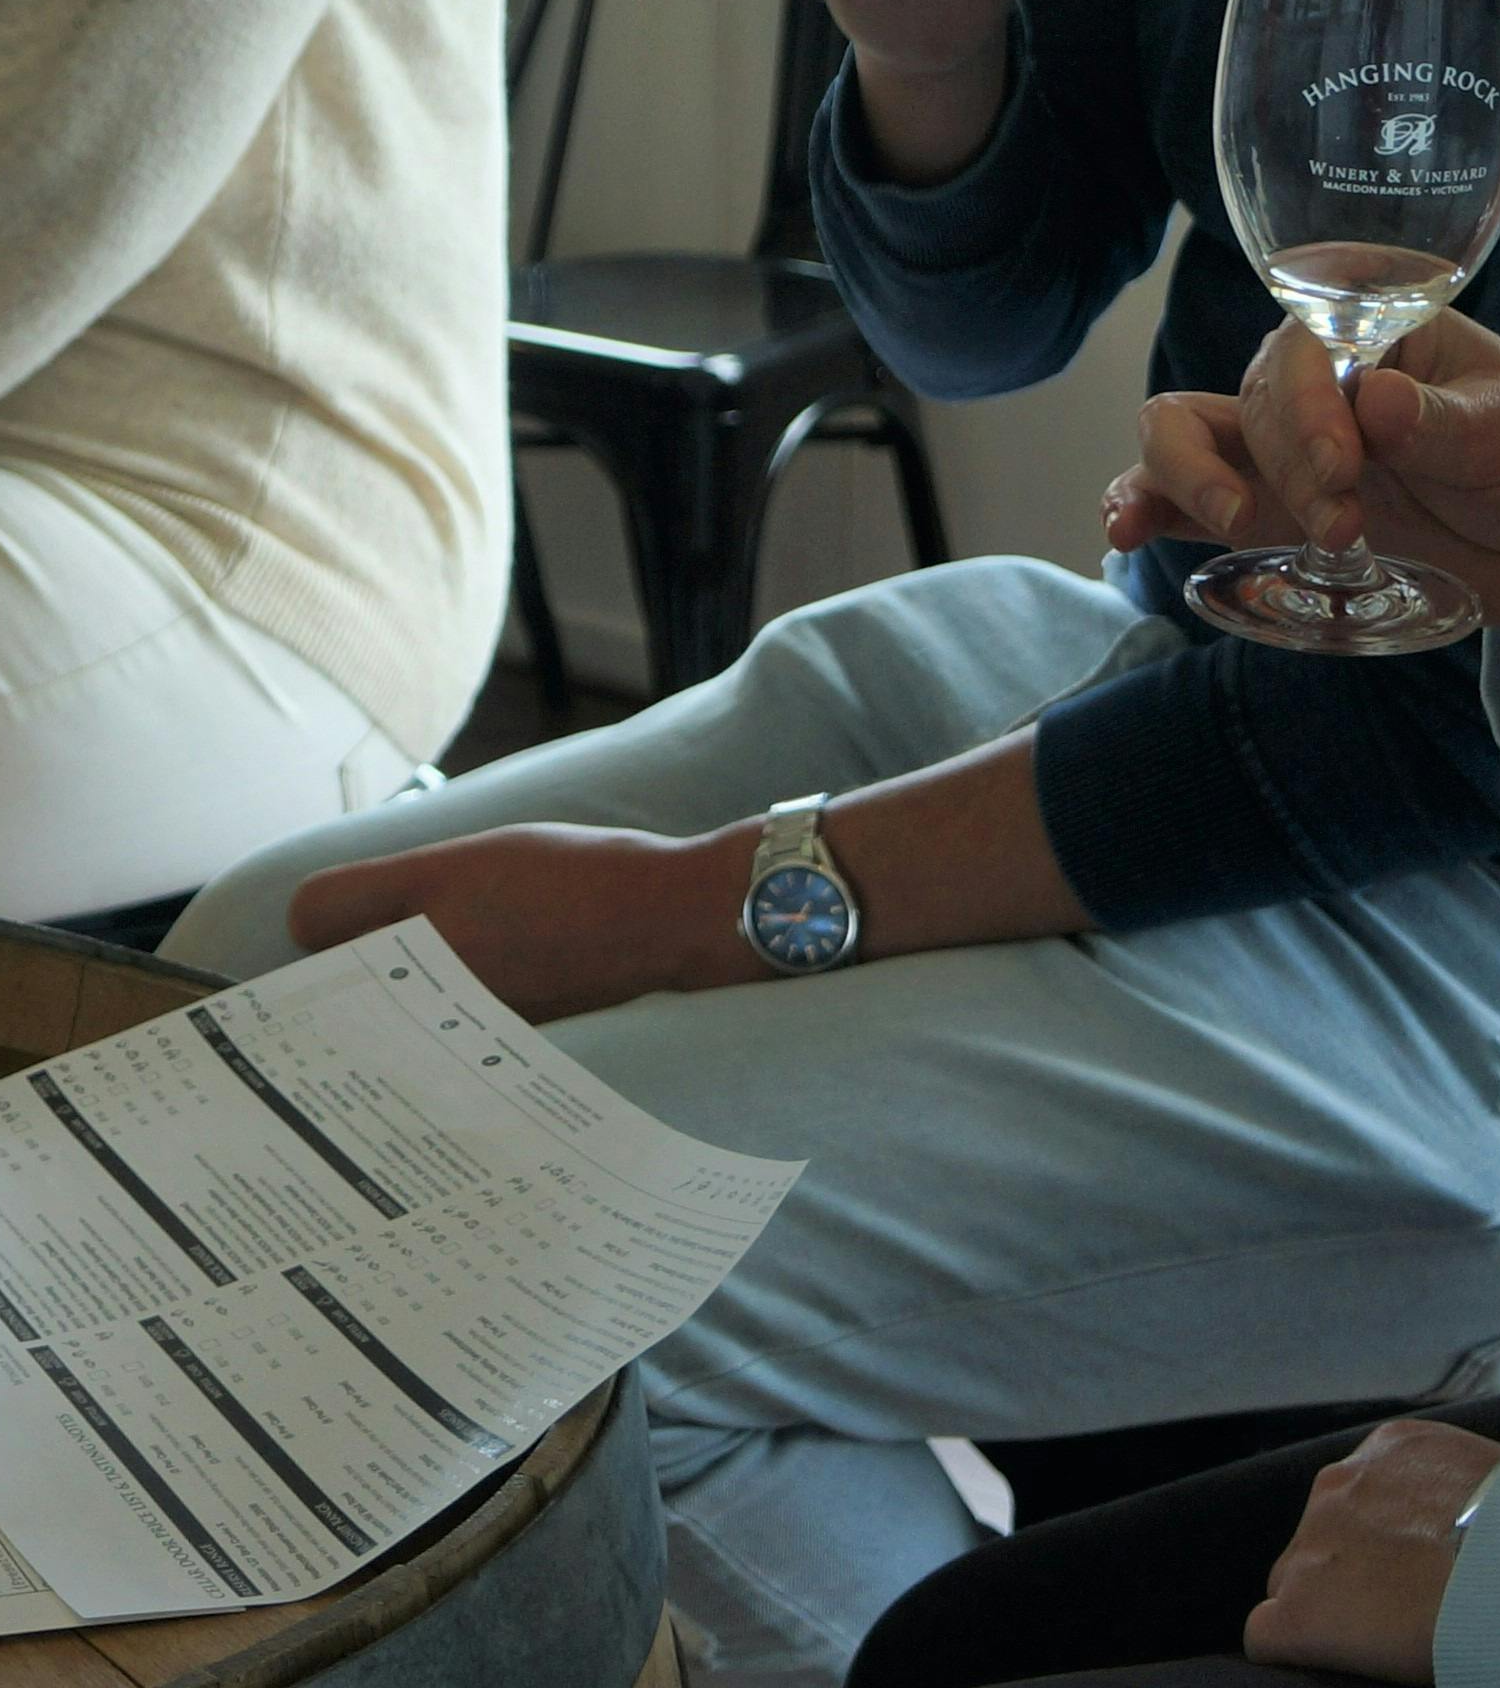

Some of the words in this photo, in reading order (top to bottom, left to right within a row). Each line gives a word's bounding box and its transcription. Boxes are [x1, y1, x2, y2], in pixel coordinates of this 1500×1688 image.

[1302, 62, 1434, 107] HANGING
[1442, 66, 1500, 111] ROCK
[1309, 160, 1379, 183] WINERY
[1386, 169, 1402, 184] &
[1411, 167, 1487, 184] VINEYARD
[1323, 181, 1378, 195] MACEDON
[1379, 184, 1422, 196] RANGES
[1431, 183, 1473, 195] VICTORIA
[56, 1412, 88, 1443] NOTES
[80, 1441, 121, 1482] TASTING
[120, 1491, 147, 1512] LIST
[136, 1511, 171, 1539] PRICE
[160, 1538, 197, 1568] DOOR
[187, 1566, 226, 1599] CELLAR
